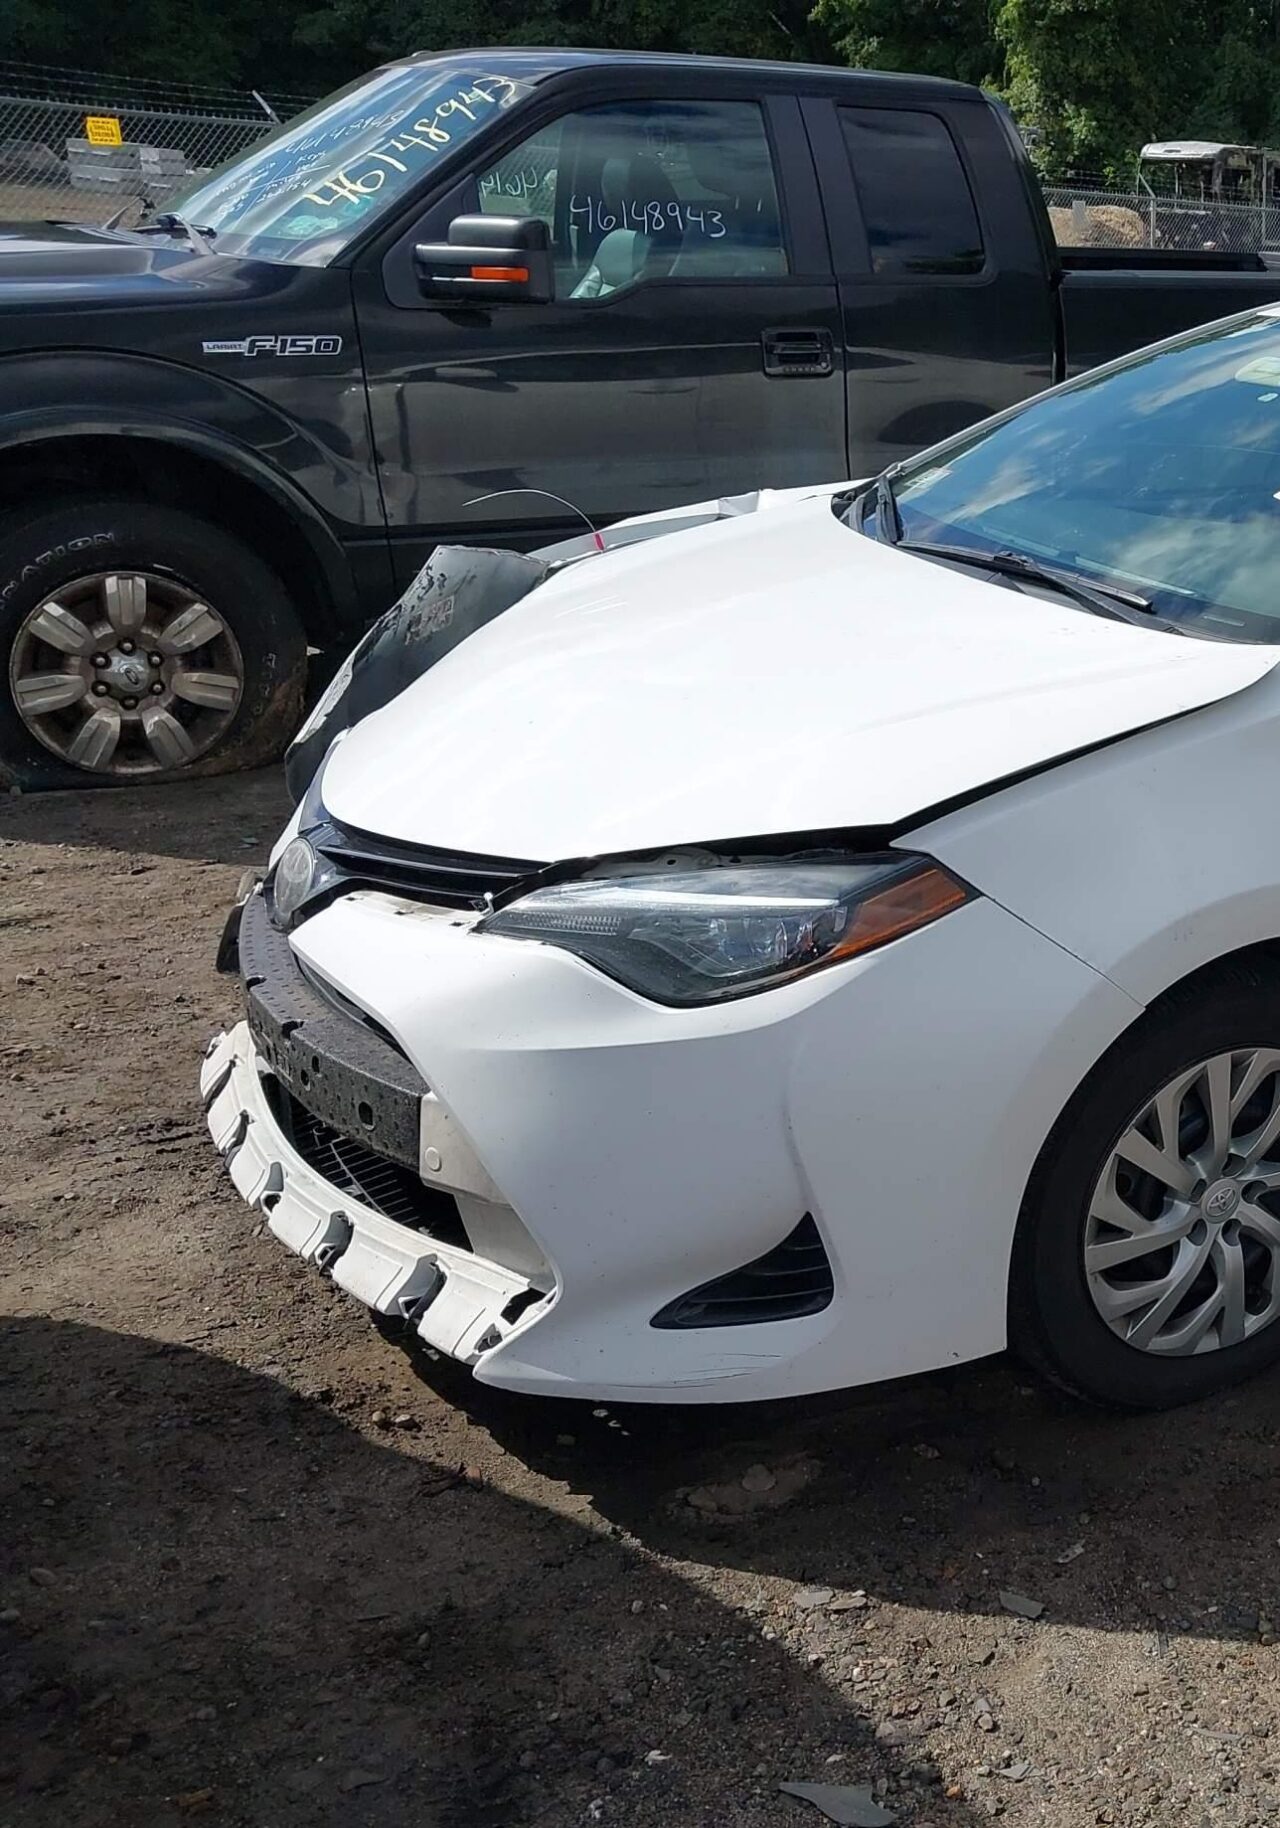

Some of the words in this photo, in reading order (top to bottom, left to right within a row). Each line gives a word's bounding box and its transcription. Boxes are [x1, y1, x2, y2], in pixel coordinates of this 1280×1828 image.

[302, 75, 516, 206] 46148943
[569, 194, 726, 238] 46148943
[244, 334, 343, 357] F-150
